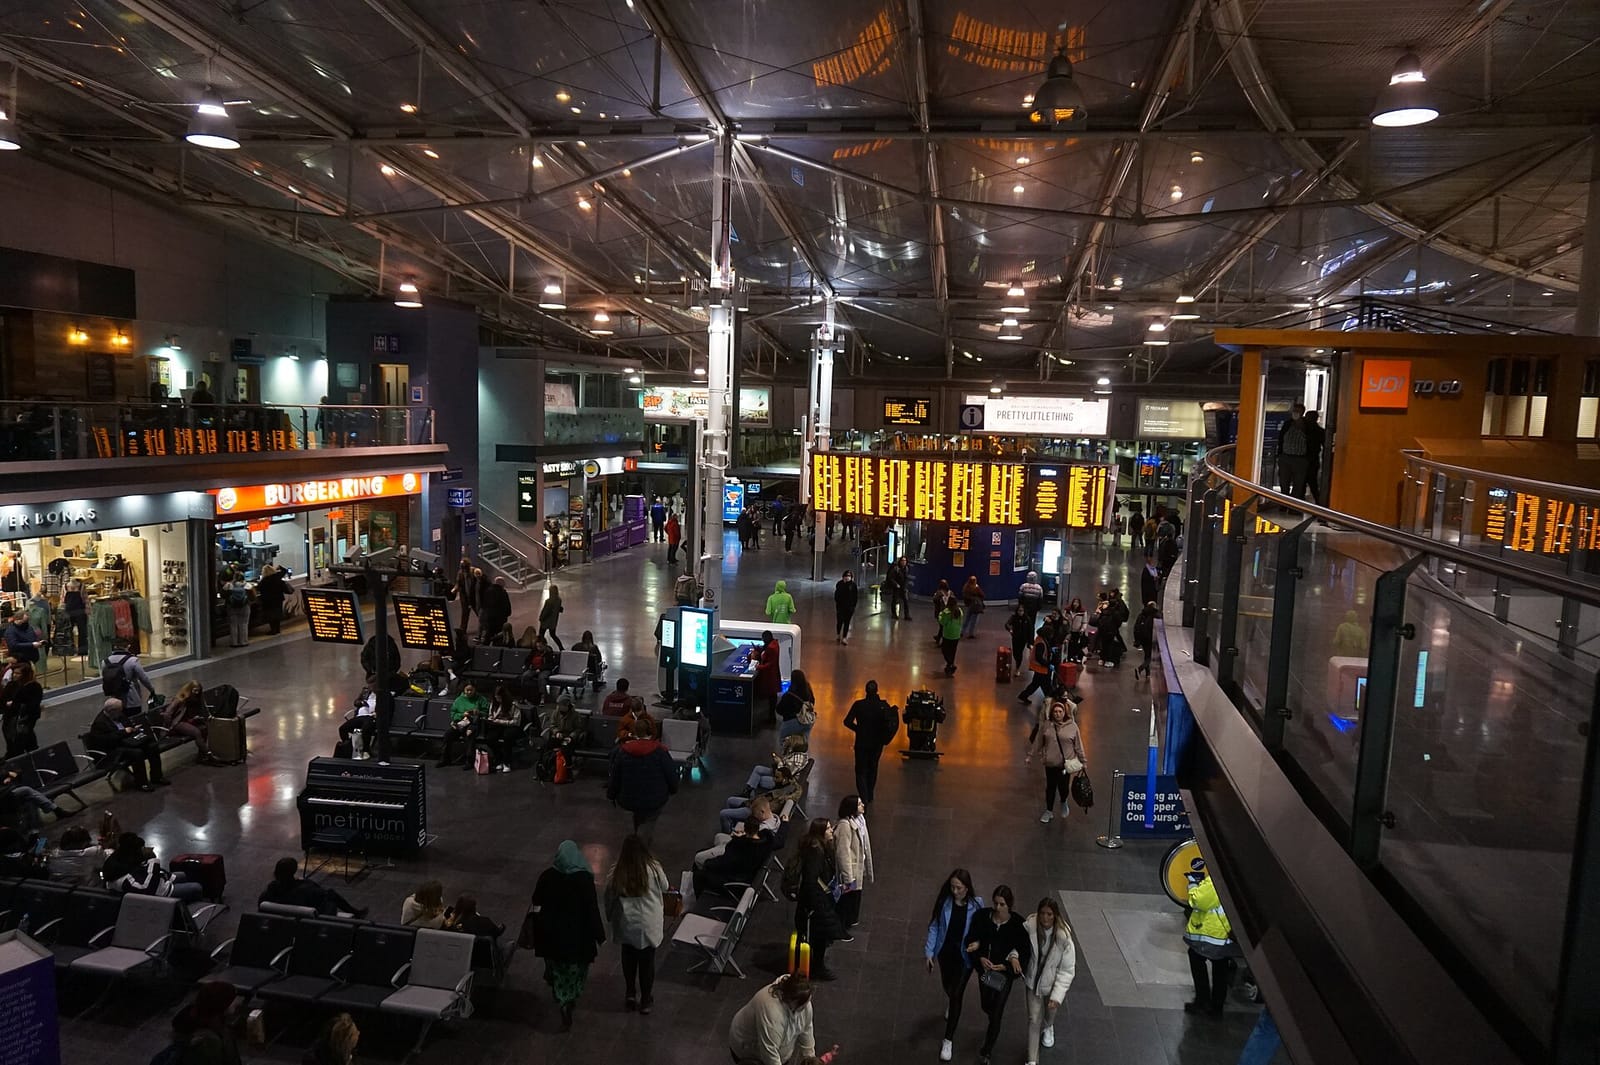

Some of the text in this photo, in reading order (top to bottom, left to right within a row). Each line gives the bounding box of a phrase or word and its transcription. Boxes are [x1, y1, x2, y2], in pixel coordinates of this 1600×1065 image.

[1415, 380, 1434, 393] TO
[1438, 380, 1462, 394] GO
[997, 410, 1074, 422] PRETTYLITTLETHING
[542, 462, 560, 474] ASTY
[560, 462, 577, 472] SHOP
[264, 479, 340, 506] BURGER
[341, 476, 386, 498] KING
[35, 507, 97, 526] BONAS
[1127, 790, 1165, 802] Seang
[1126, 801, 1176, 813] the pper
[314, 812, 405, 833] metirium
[1126, 811, 1179, 822] Conourse
